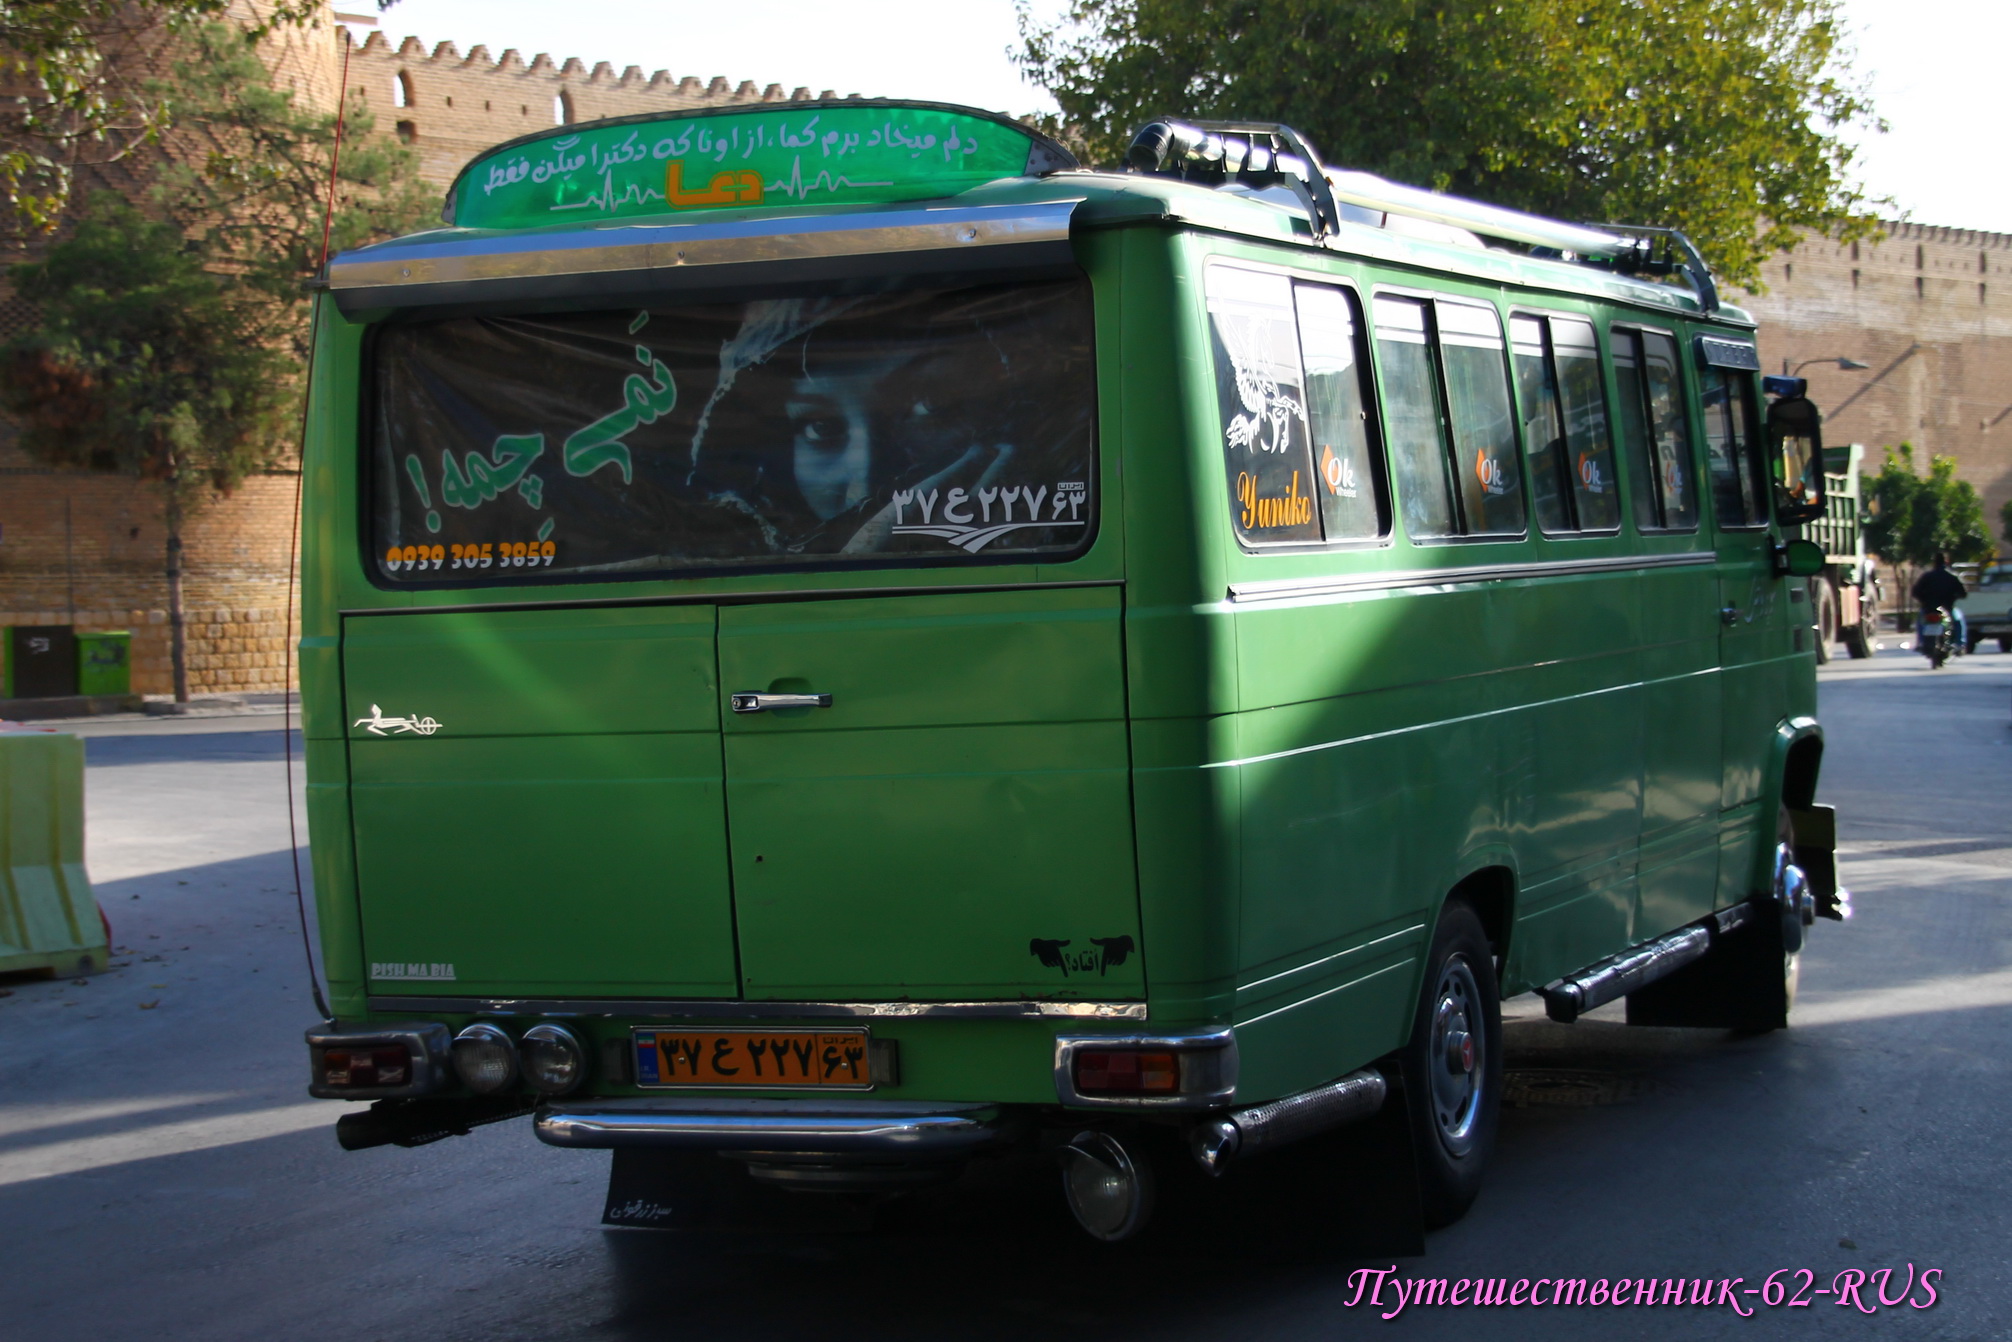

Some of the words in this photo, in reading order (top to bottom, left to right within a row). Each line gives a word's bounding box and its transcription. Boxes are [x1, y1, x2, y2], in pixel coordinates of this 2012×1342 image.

[591, 130, 648, 175] دکترا
[652, 123, 695, 160] که
[698, 126, 740, 162] اونا
[741, 125, 764, 159] از
[821, 130, 860, 157] برم
[867, 122, 937, 158] میخاد
[943, 125, 978, 162] دلم
[483, 157, 531, 196] فقط
[531, 135, 586, 184] میگن
[1327, 457, 1356, 488] Ok
[1481, 458, 1503, 486] Ok
[1582, 460, 1601, 485] Ok
[1237, 470, 1312, 530] Yuniko
[385, 544, 446, 572] 0939
[450, 543, 493, 570] 305
[499, 540, 557, 568] 3859
[371, 962, 405, 976] PISH
[407, 963, 428, 976] MA
[431, 963, 455, 976] BIA
